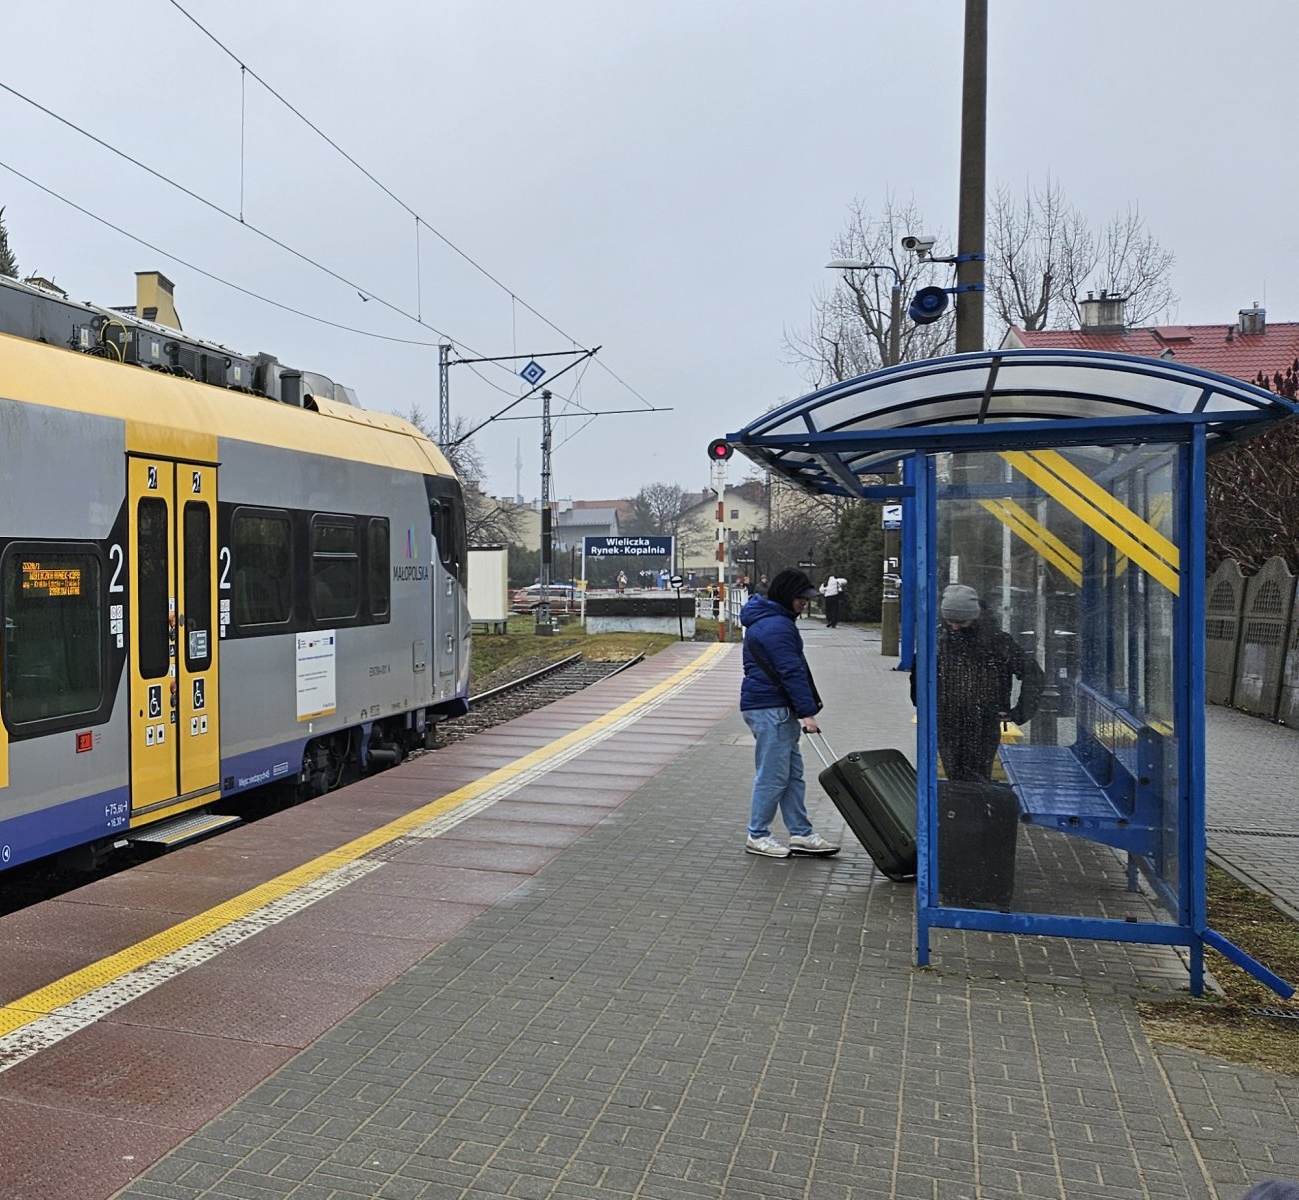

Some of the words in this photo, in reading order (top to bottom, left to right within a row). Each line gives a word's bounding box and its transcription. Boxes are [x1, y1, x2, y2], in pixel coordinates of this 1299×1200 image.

[606, 538, 650, 546] Wieliczka
[109, 543, 124, 593] 2
[219, 546, 231, 590] 2
[393, 566, 429, 581] MAŁOPOLSKA
